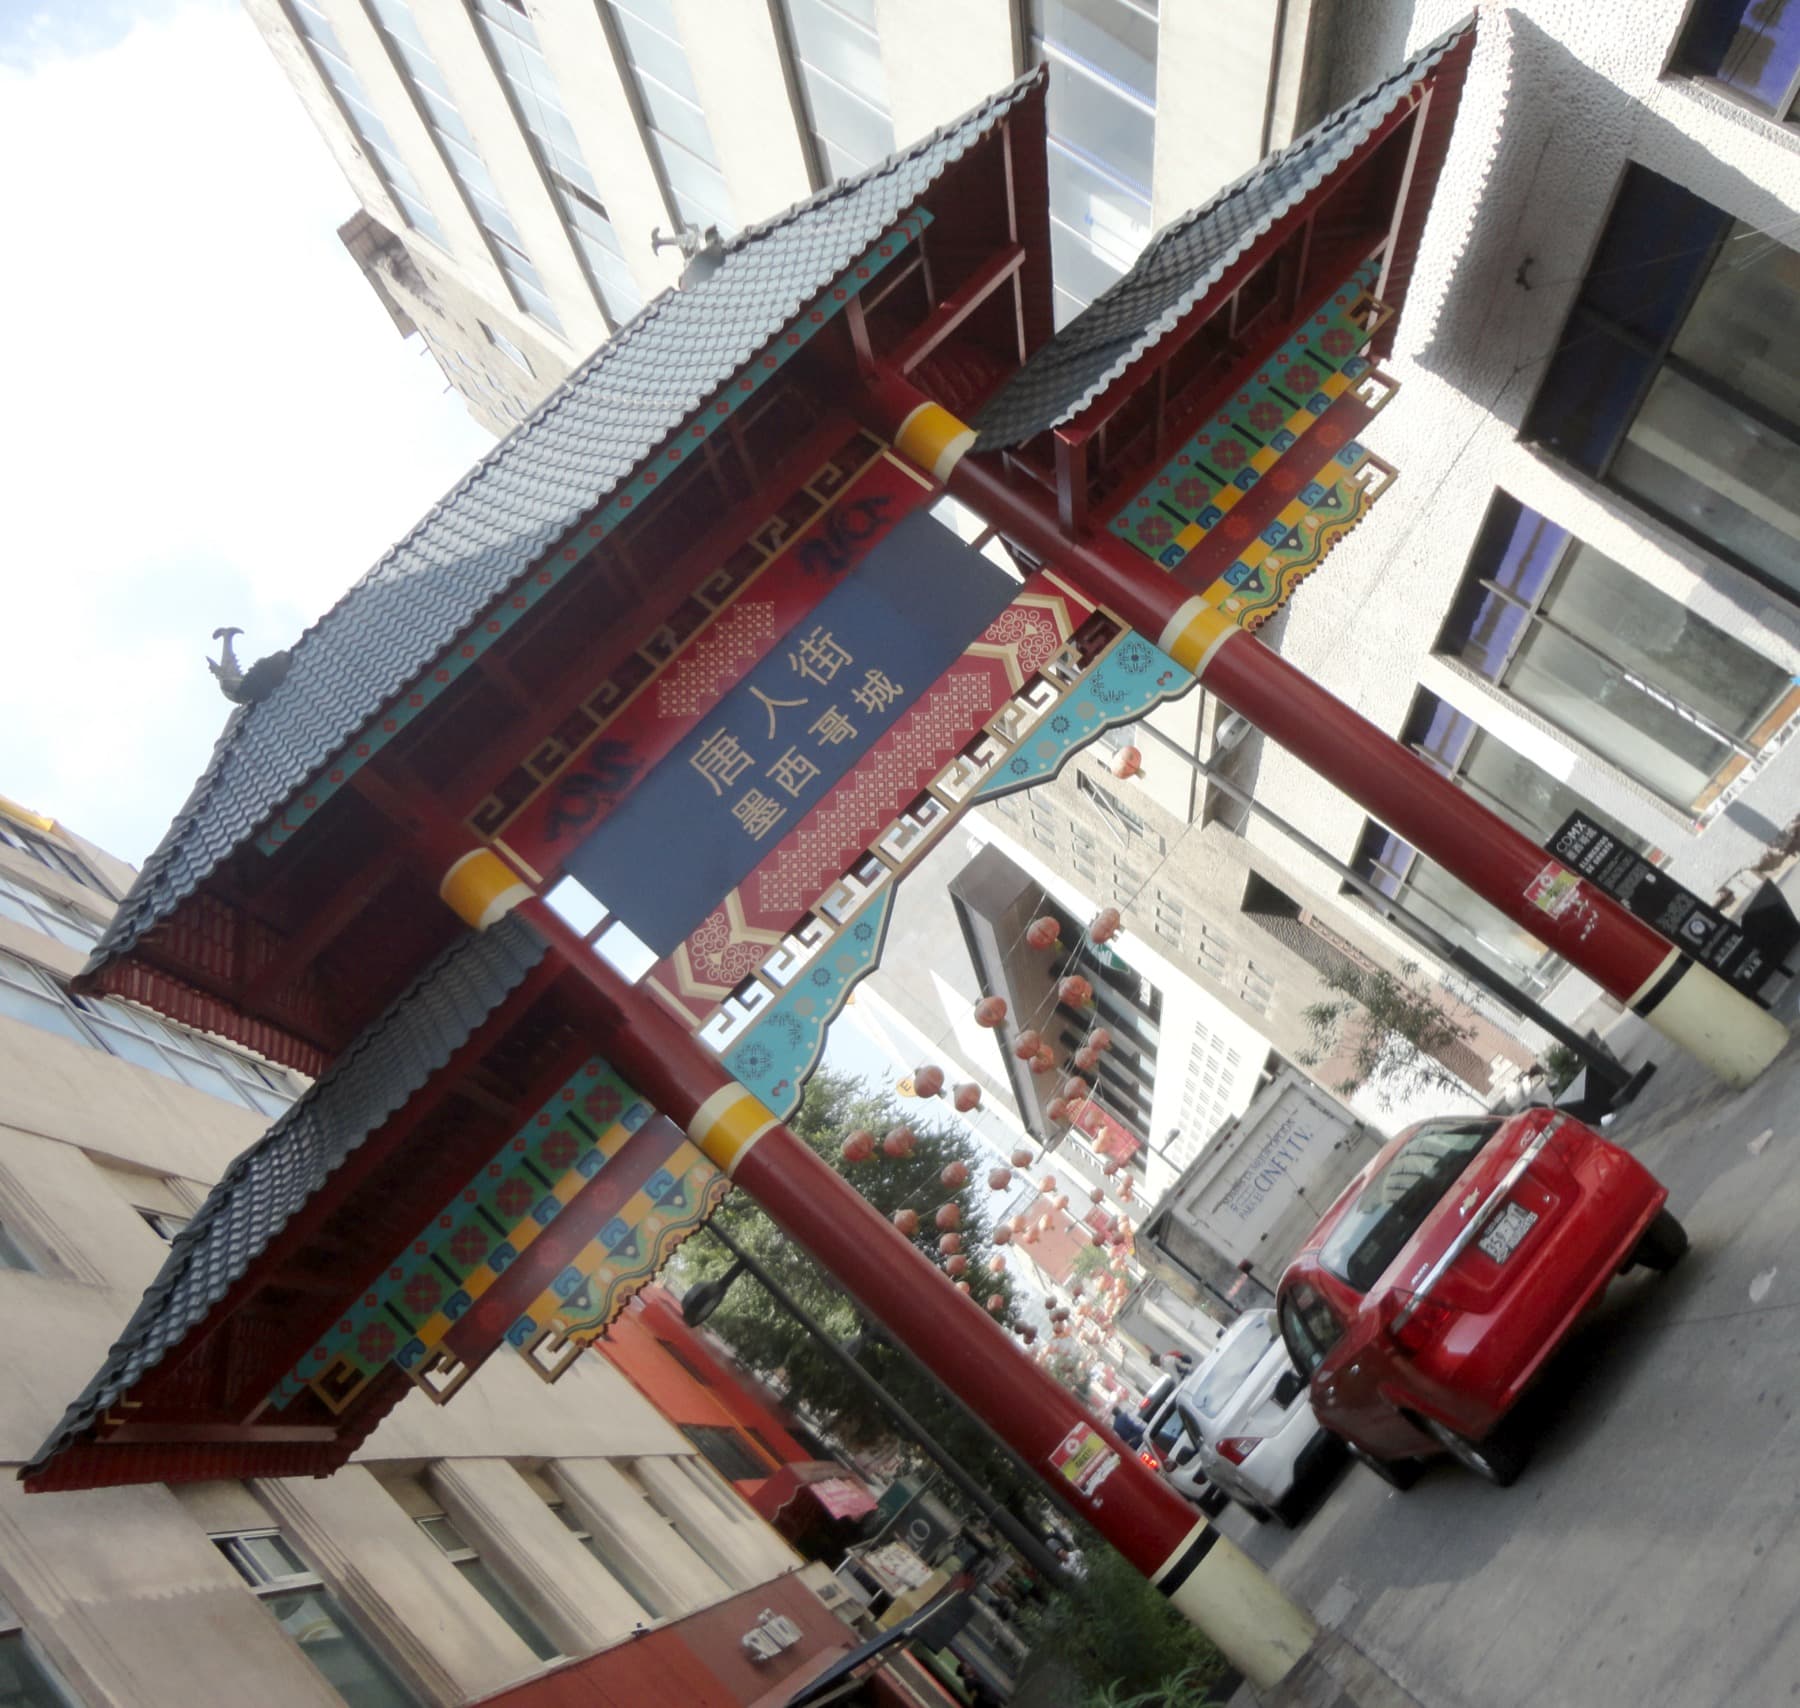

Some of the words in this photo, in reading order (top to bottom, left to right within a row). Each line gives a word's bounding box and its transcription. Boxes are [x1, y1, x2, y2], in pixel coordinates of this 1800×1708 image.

[689, 626, 854, 797] 唐人街
[731, 668, 904, 842] 墨西哥城
[1556, 819, 1587, 853] CDMX
